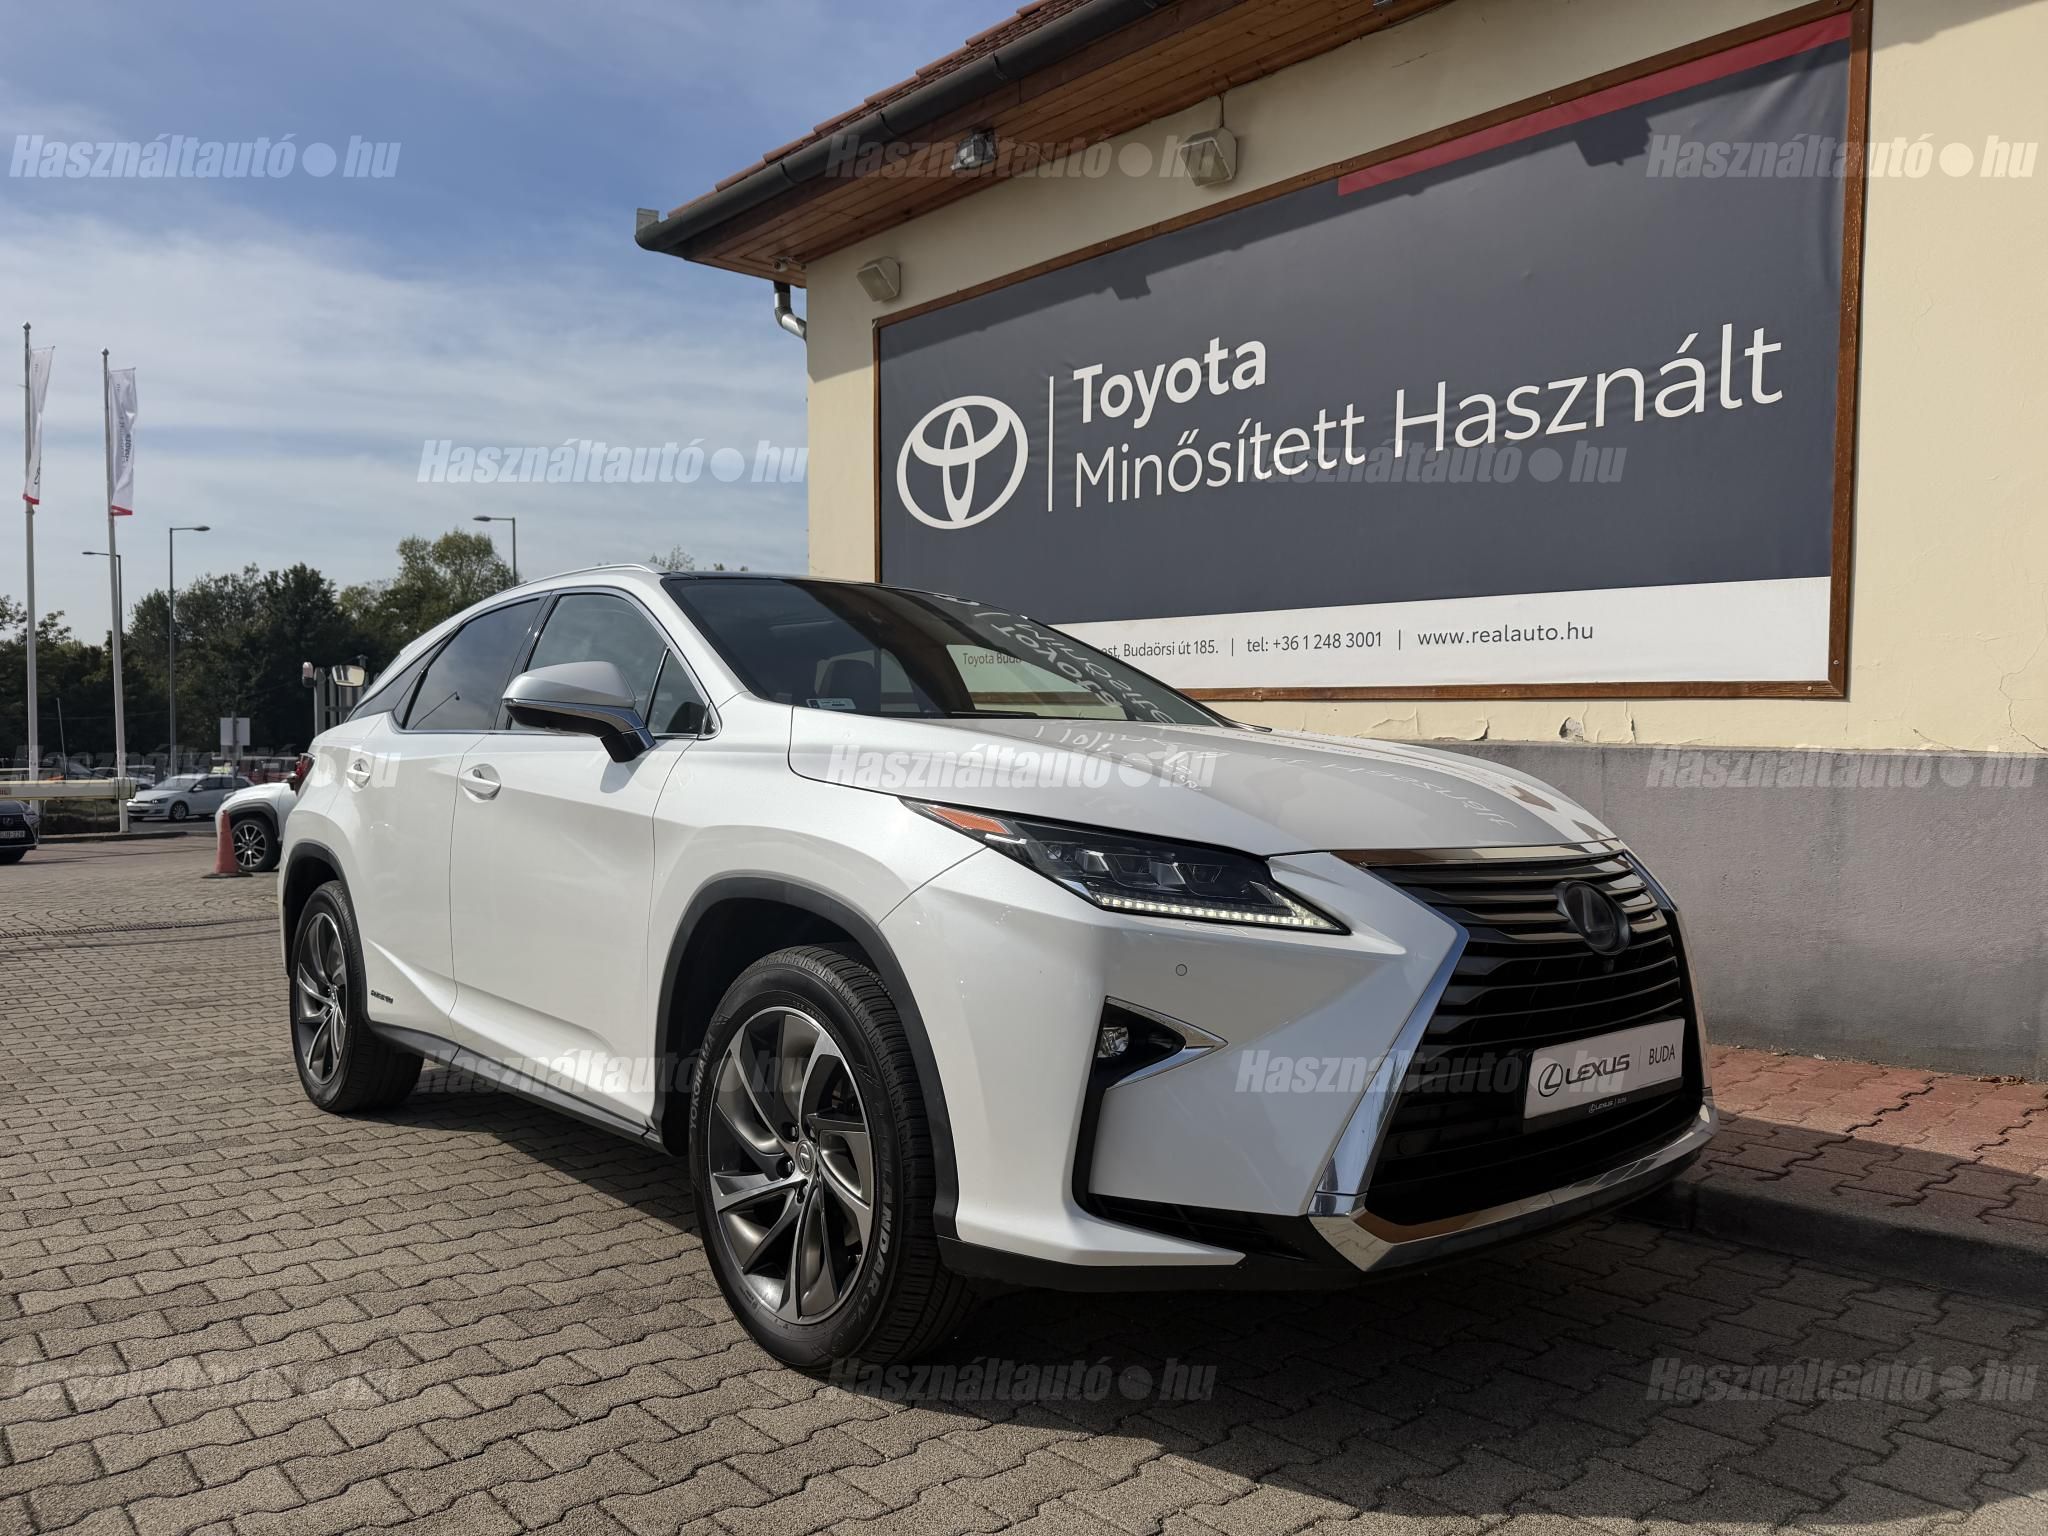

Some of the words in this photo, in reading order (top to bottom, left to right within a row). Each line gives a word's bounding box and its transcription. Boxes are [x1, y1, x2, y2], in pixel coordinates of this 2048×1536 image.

[1073, 337, 1267, 429] Toyota
[1075, 404, 1366, 508] Minősített
[1394, 323, 1783, 458] Használt
[962, 652, 994, 668] Toyota
[1123, 640, 1175, 657] Budaörsi
[1178, 640, 1191, 655] út
[1193, 639, 1219, 655] 185.
[1247, 636, 1269, 653] tel:
[1273, 635, 1299, 651] +36
[1302, 635, 1309, 650] 1
[1313, 633, 1342, 649] 248
[1346, 631, 1382, 648] 3001
[1417, 621, 1594, 646] www.realauto.hu
[689, 1033, 716, 1130] YOKOHAMA
[1565, 1054, 1631, 1084] LEXUS
[1648, 1043, 1676, 1065] BUDA
